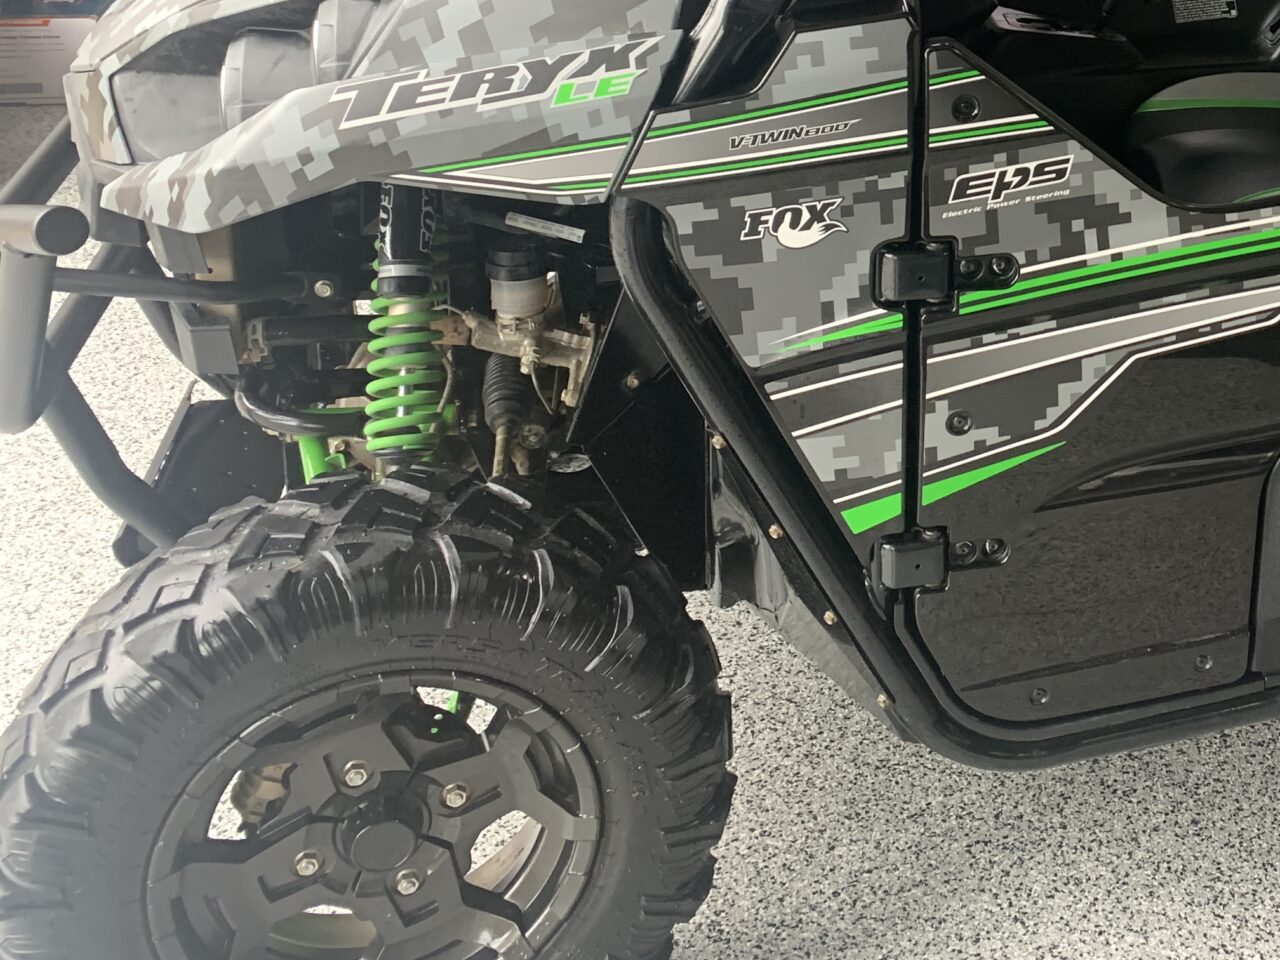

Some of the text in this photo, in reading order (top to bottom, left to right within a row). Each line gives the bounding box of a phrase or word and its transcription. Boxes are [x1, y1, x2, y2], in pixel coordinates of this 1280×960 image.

[328, 34, 667, 130] TERYX
[551, 68, 648, 108] LE
[942, 189, 1070, 219] Electric Power Steering
[948, 154, 1075, 204] EPS
[739, 196, 849, 249] FOX
